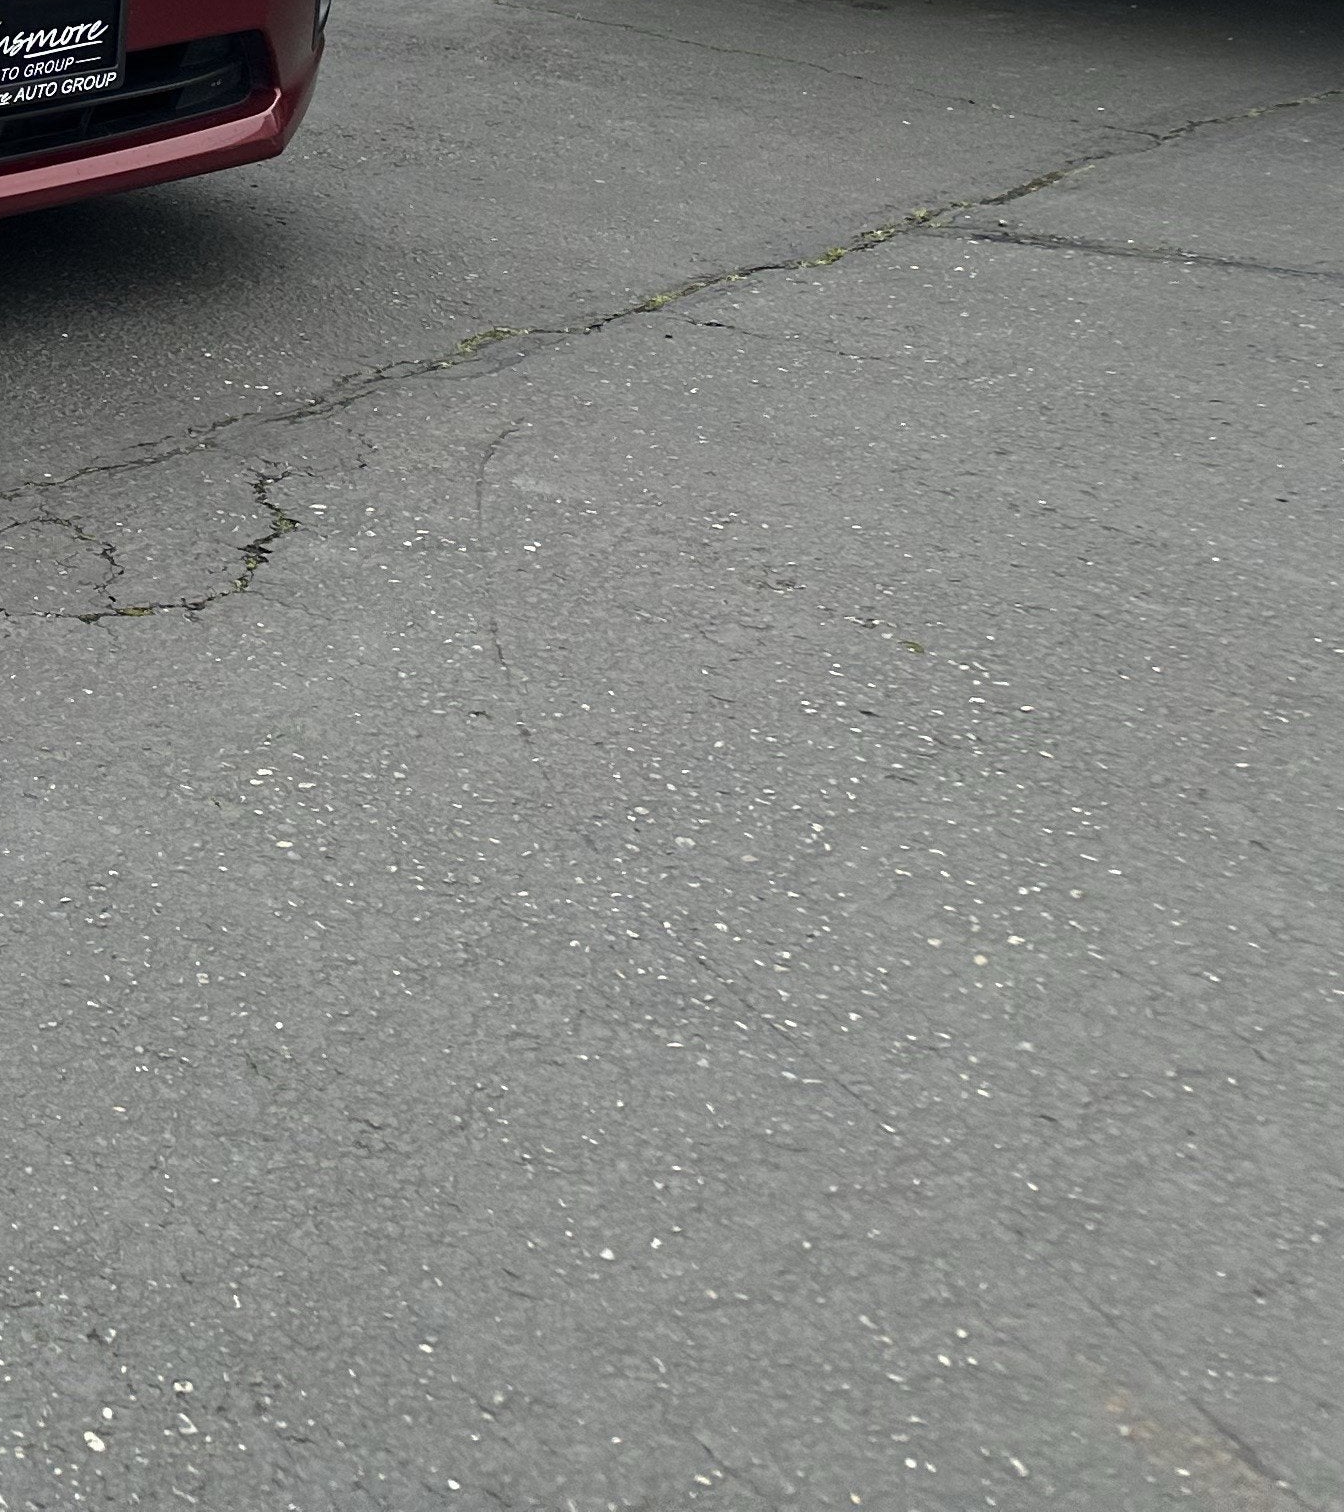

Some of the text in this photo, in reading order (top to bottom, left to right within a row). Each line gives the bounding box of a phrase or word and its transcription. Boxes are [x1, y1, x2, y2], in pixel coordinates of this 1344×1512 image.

[23, 56, 75, 78] GROUP
[13, 81, 57, 103] AUTO
[61, 71, 117, 94] GROUP
